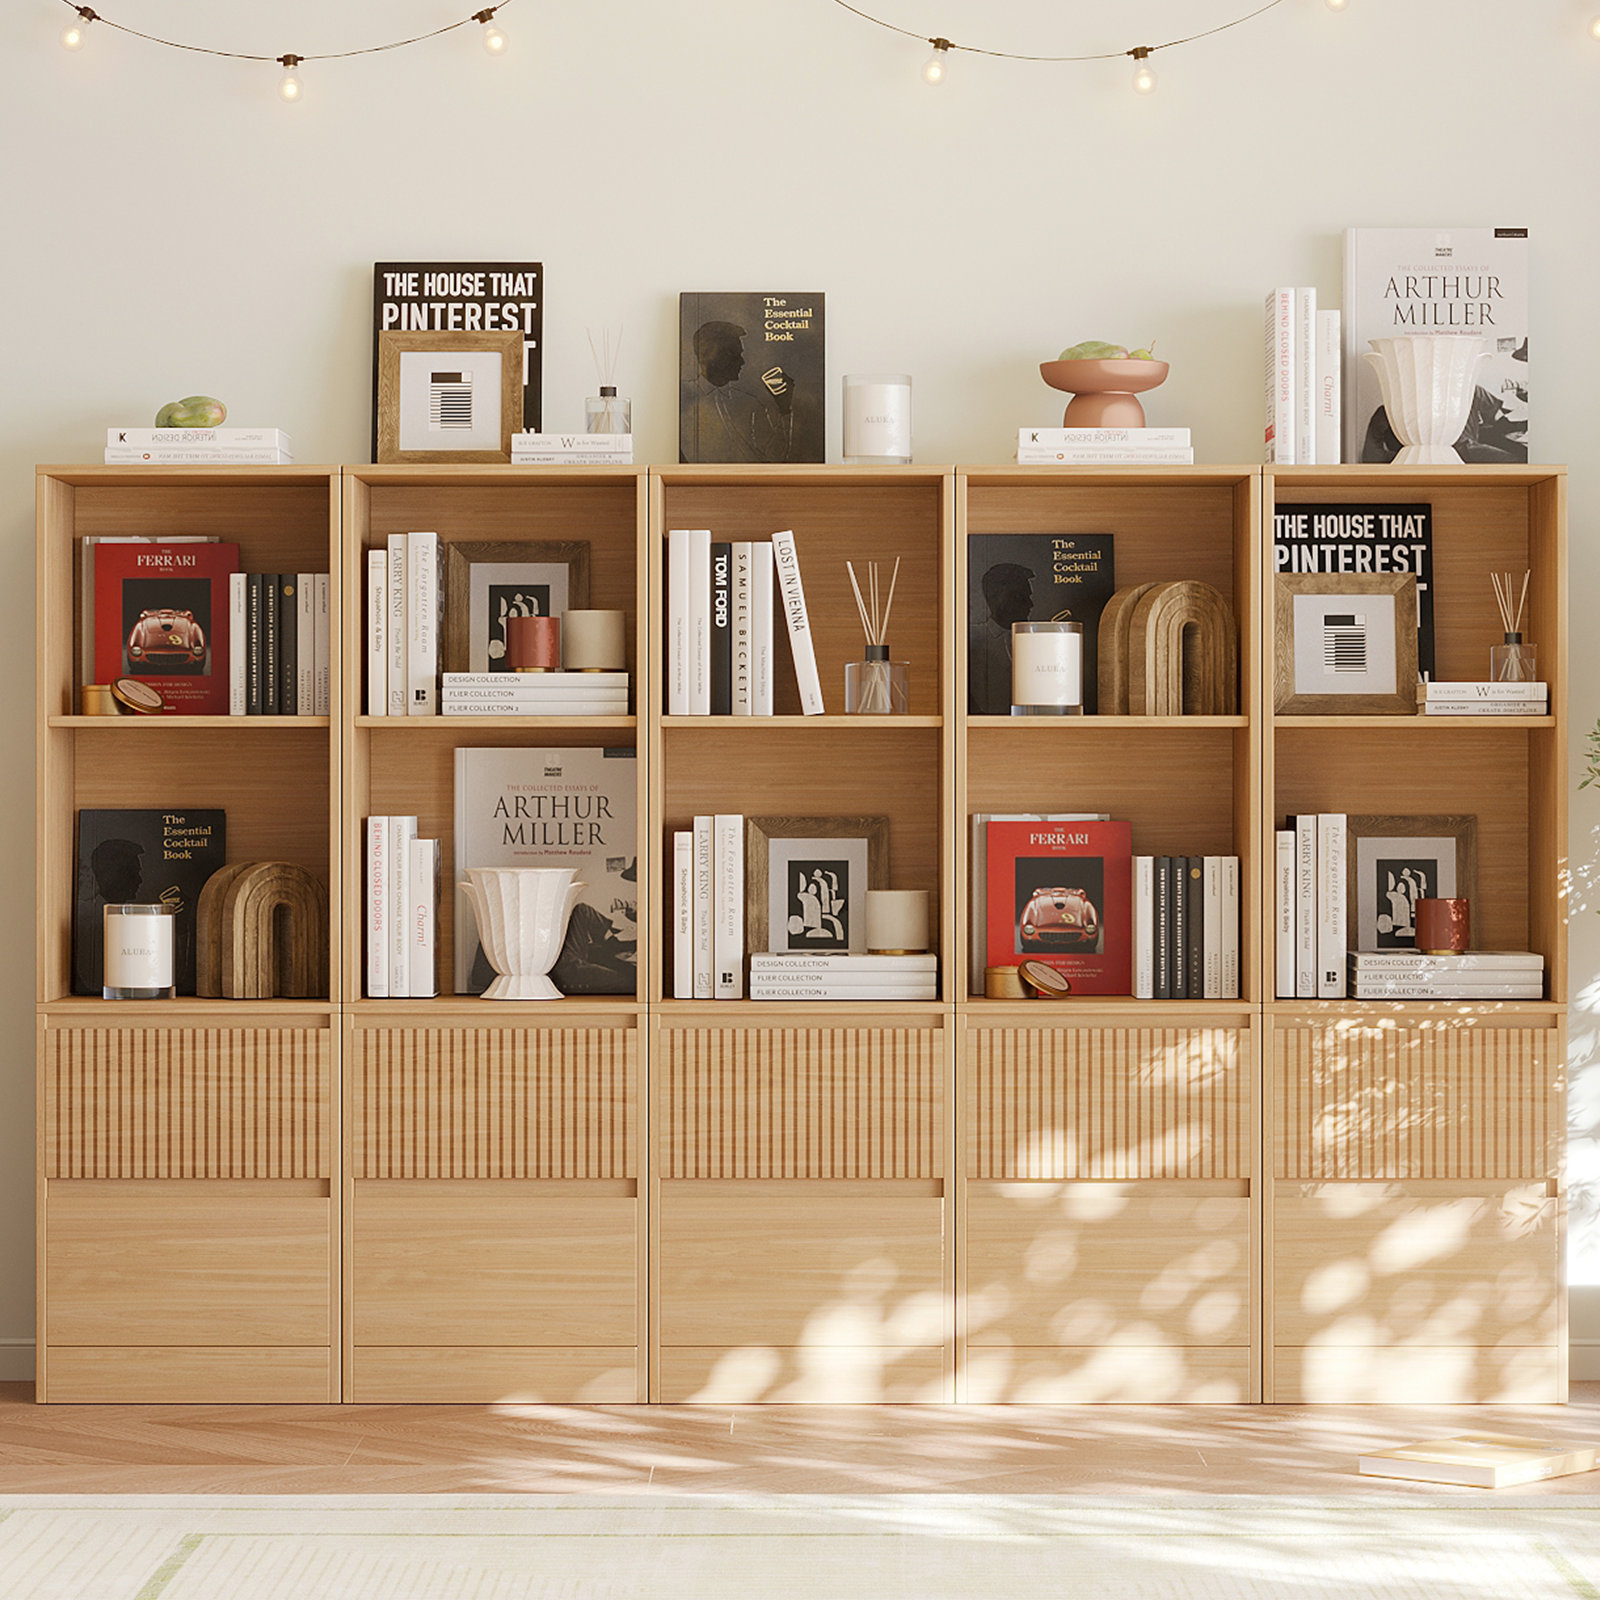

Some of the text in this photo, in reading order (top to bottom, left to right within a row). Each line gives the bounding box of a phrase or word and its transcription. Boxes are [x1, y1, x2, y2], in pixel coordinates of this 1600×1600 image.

[384, 272, 536, 296] THE HOUSE THAT
[1384, 276, 1504, 299] ARTHUR
[763, 298, 786, 307] The
[764, 308, 812, 318] Essential
[1394, 302, 1496, 326] MILLER
[382, 302, 536, 334] PINTEREST
[764, 320, 809, 330] Cocktail
[765, 332, 794, 342] Book
[1281, 294, 1289, 402] BEHIND CLOSED DOORS
[1324, 376, 1334, 418] Charm!
[119, 432, 126, 442] K
[560, 438, 575, 448] W
[1031, 432, 1038, 442] K
[1274, 514, 1426, 539] THE HOUSE THAT
[1052, 540, 1075, 549] The
[1053, 550, 1102, 560] Essential
[137, 555, 196, 566] FERRARI
[1054, 562, 1098, 572] Cocktail
[1274, 544, 1426, 576] PINTEREST
[392, 547, 402, 618] LARRY KING
[778, 540, 806, 632] LOST IN VIENNA
[1054, 574, 1083, 584] Book
[420, 544, 429, 654] The Forgotten Room
[715, 554, 727, 628] TOM FORD
[738, 554, 746, 704] SAMUEL BECKETT
[1476, 686, 1491, 696] W
[522, 784, 563, 792] COLLECTED
[564, 784, 588, 792] ESSAYS
[493, 796, 614, 819] ARTHUR
[163, 815, 186, 824] The
[164, 826, 212, 836] Essential
[164, 838, 208, 848] Cocktail
[502, 822, 607, 846] MILLER
[1030, 833, 1088, 845] FERRARI
[164, 850, 192, 860] Book
[700, 829, 708, 900] LARRY KING
[1302, 829, 1312, 899] LARRY KING
[374, 823, 382, 932] BEHIND CLOSED DOORS
[680, 868, 688, 907] Shopaholic
[726, 827, 736, 937] The Forgotten Room
[1282, 868, 1290, 906] Shopaholic
[1330, 826, 1340, 935] The Forgotten Room
[416, 904, 427, 947] Charm!
